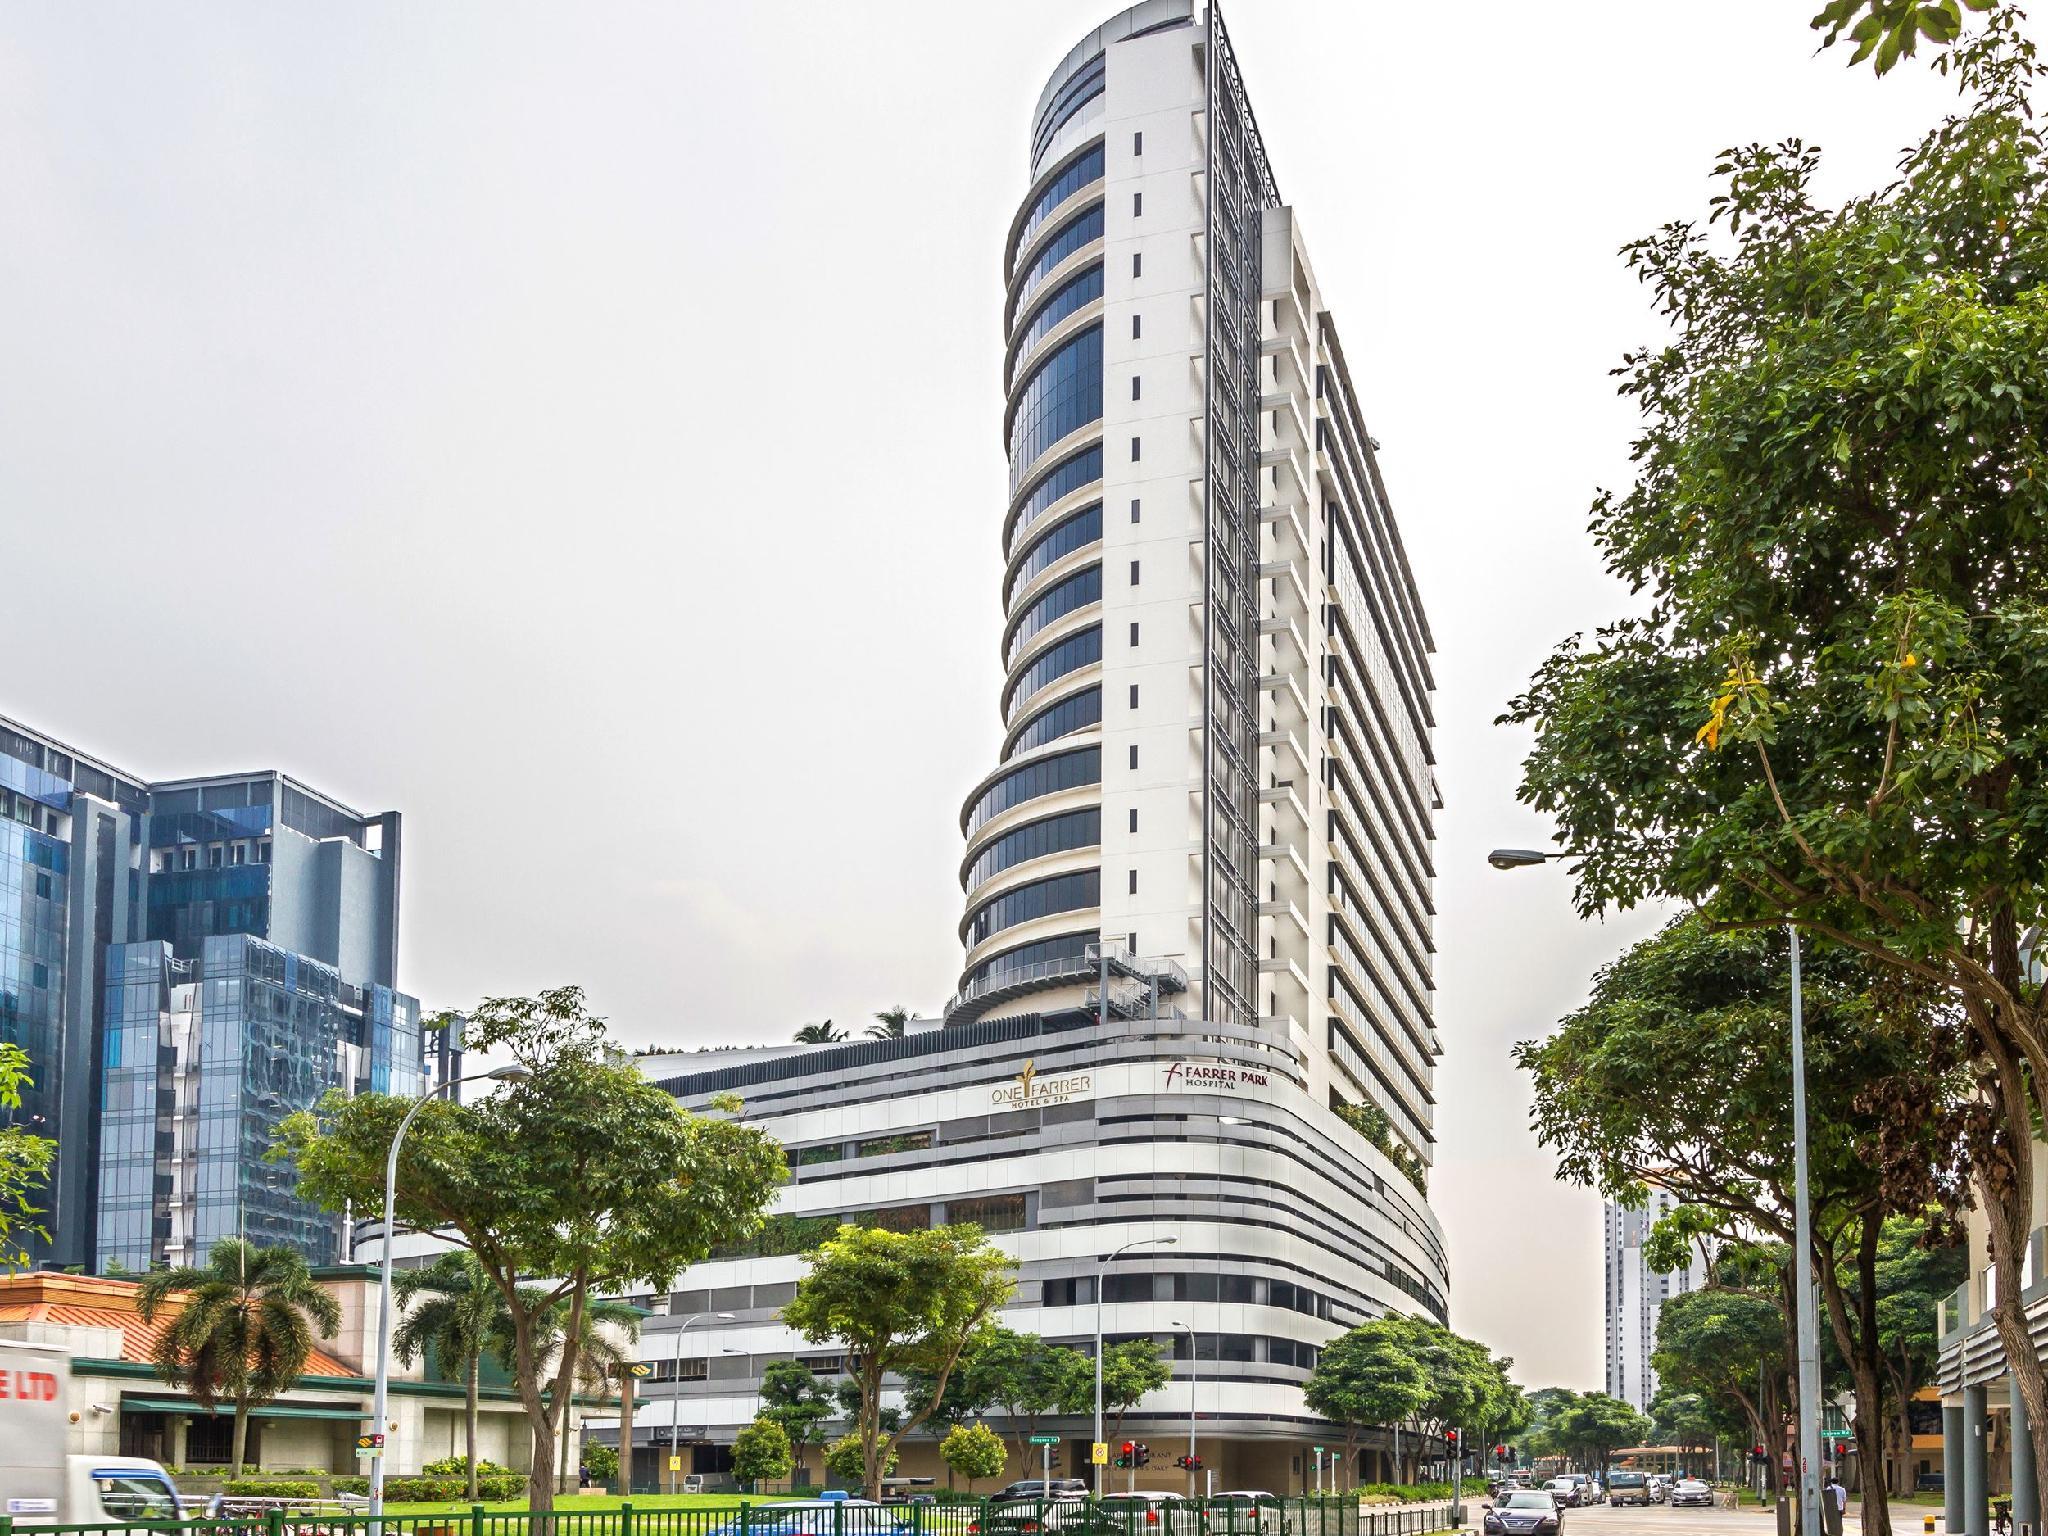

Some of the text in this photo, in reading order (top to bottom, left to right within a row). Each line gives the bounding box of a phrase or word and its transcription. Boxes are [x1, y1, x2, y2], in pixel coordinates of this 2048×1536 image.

[1186, 1067, 1268, 1086] FARRER PARK
[1186, 1079, 1235, 1089] HOSPITAL
[992, 1076, 1090, 1102] ONE FARRER
[1012, 1098, 1040, 1108] HOTEL
[16, 1371, 58, 1400] LTD
